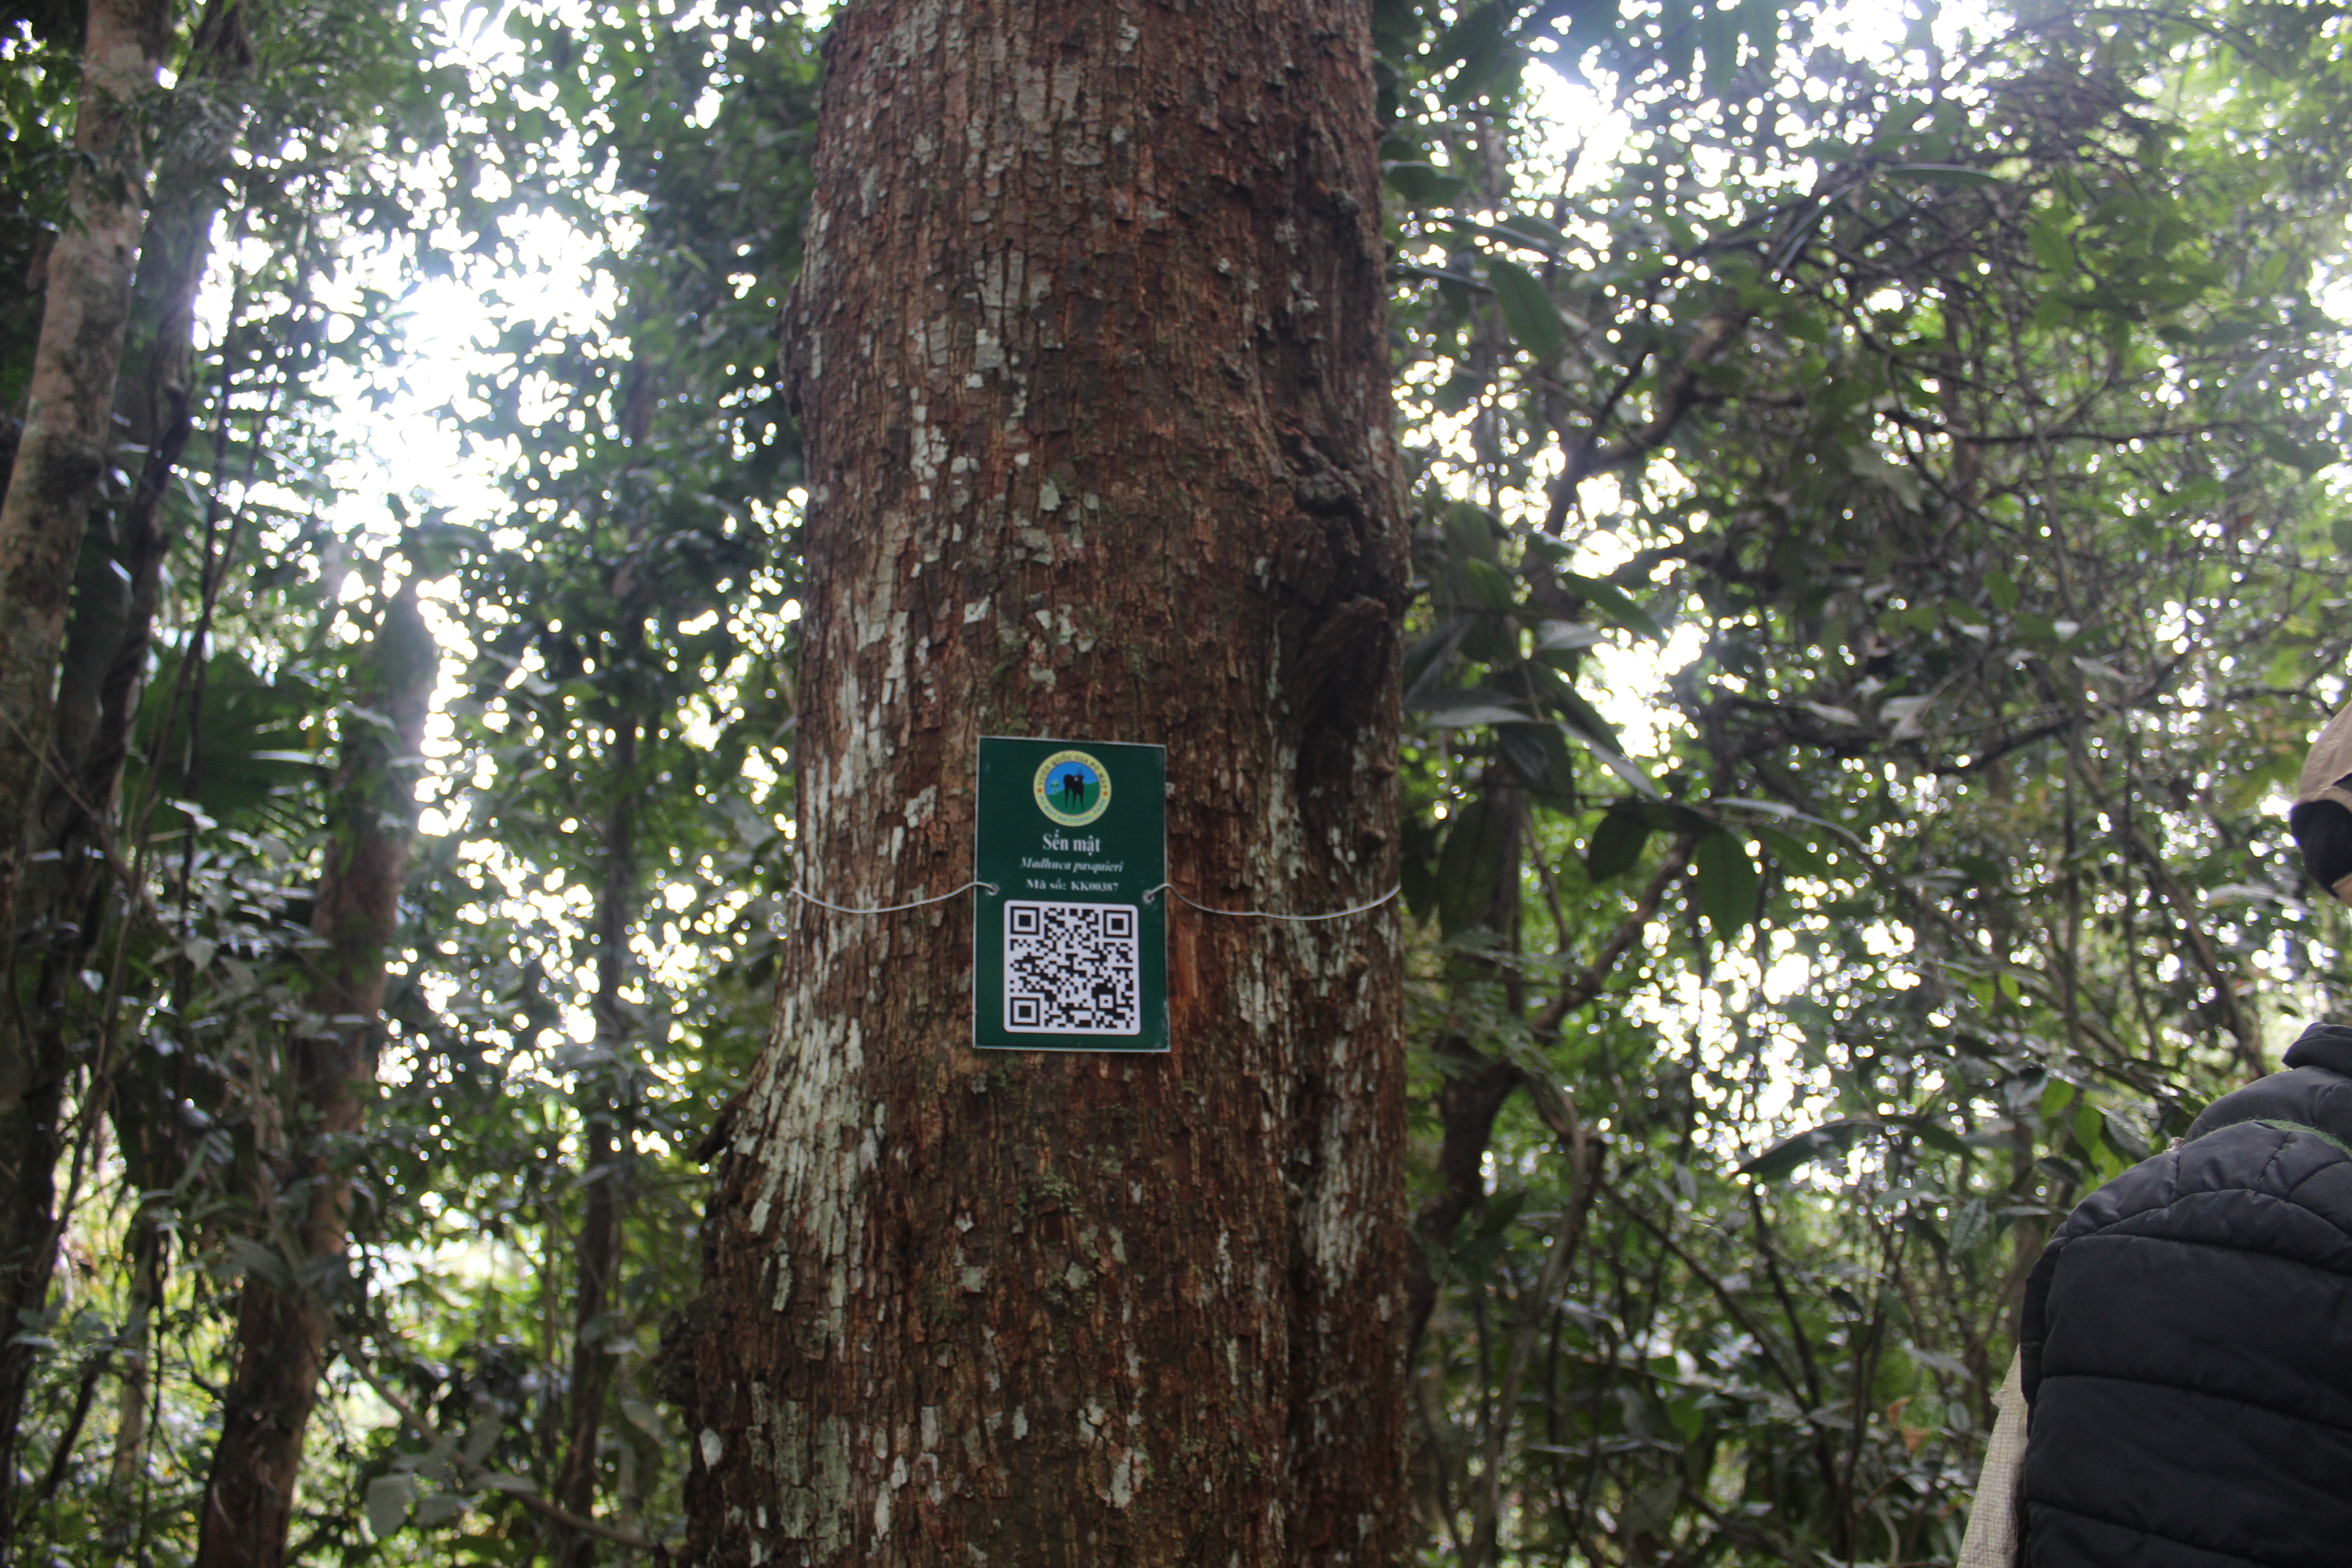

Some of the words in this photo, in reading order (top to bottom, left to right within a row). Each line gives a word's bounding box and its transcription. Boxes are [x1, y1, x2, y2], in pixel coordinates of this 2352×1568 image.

[1042, 828, 1069, 851] Sến
[1073, 834, 1101, 857] mật
[1020, 857, 1072, 870] Madhuca
[1073, 861, 1123, 874] pasquieri
[1026, 878, 1046, 890] Mã
